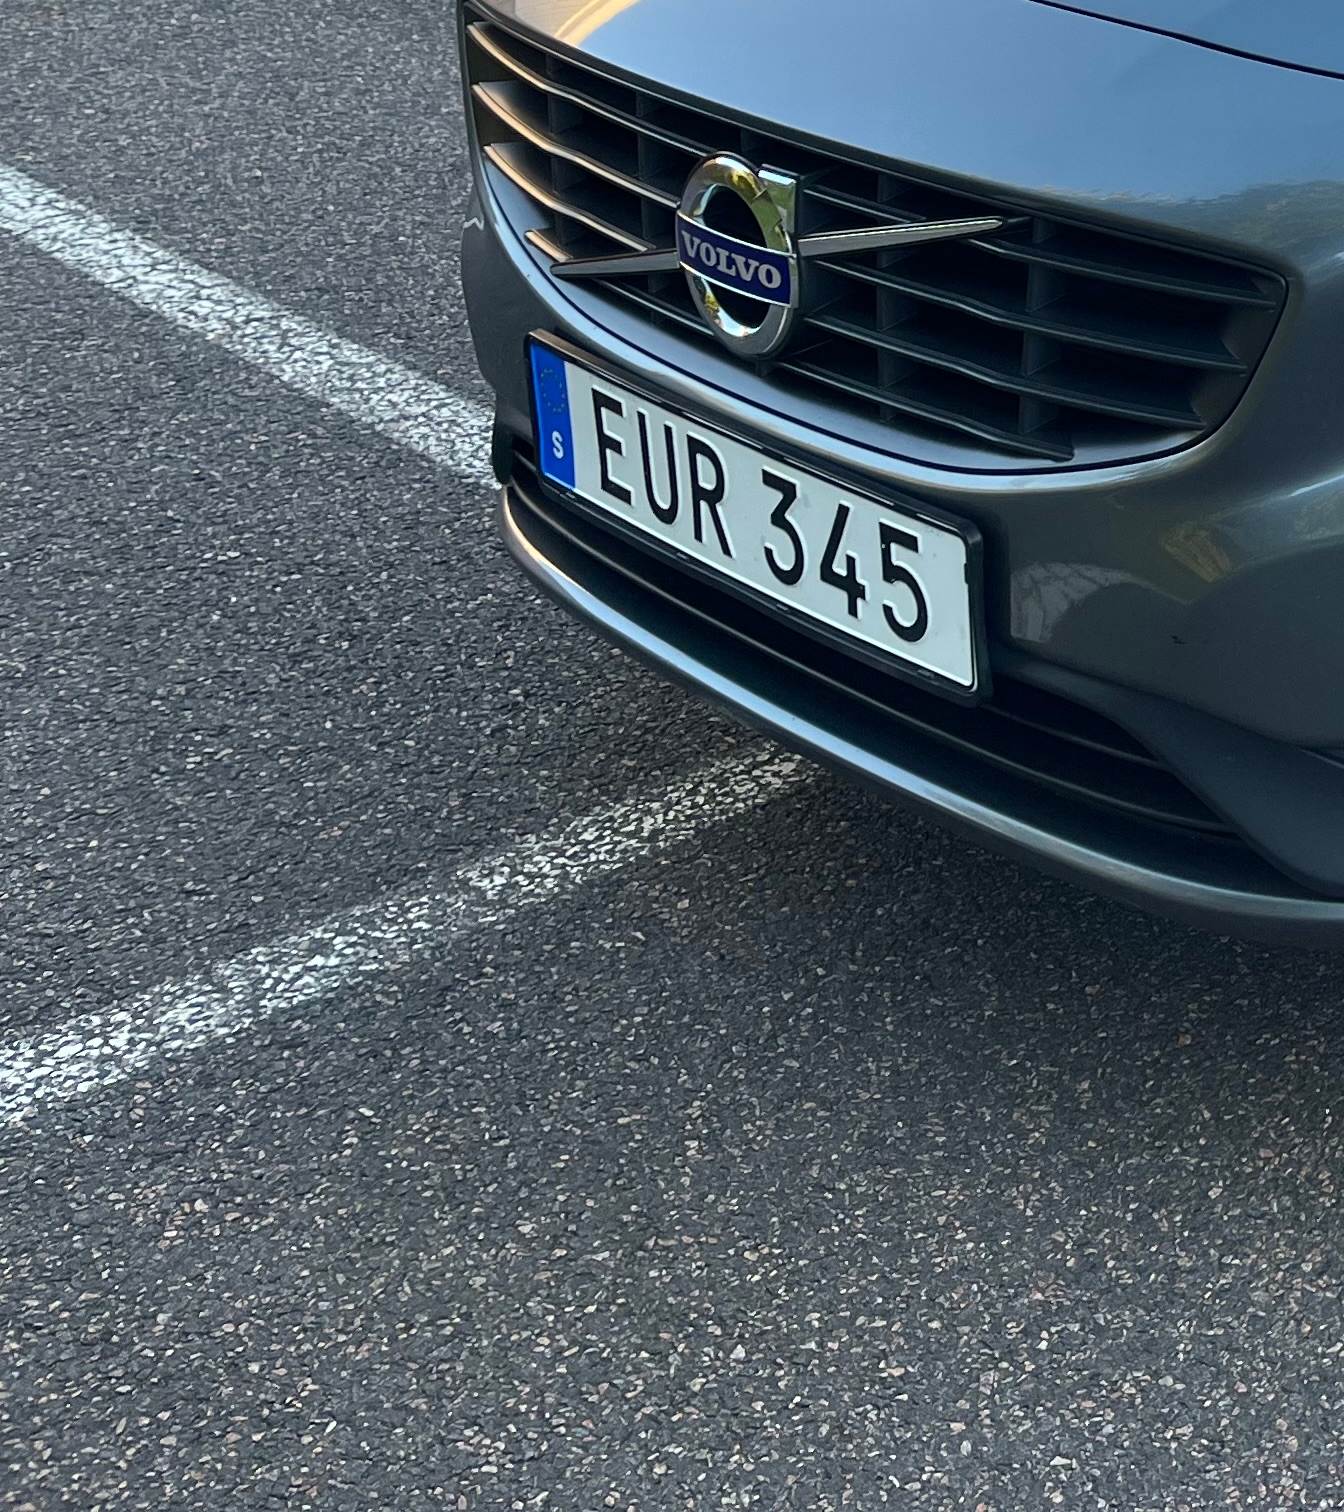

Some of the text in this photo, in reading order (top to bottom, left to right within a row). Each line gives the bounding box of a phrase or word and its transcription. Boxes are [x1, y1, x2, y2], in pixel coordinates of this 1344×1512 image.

[680, 228, 784, 290] VOLVO
[551, 429, 565, 460] S
[591, 386, 930, 644] EUR 345
